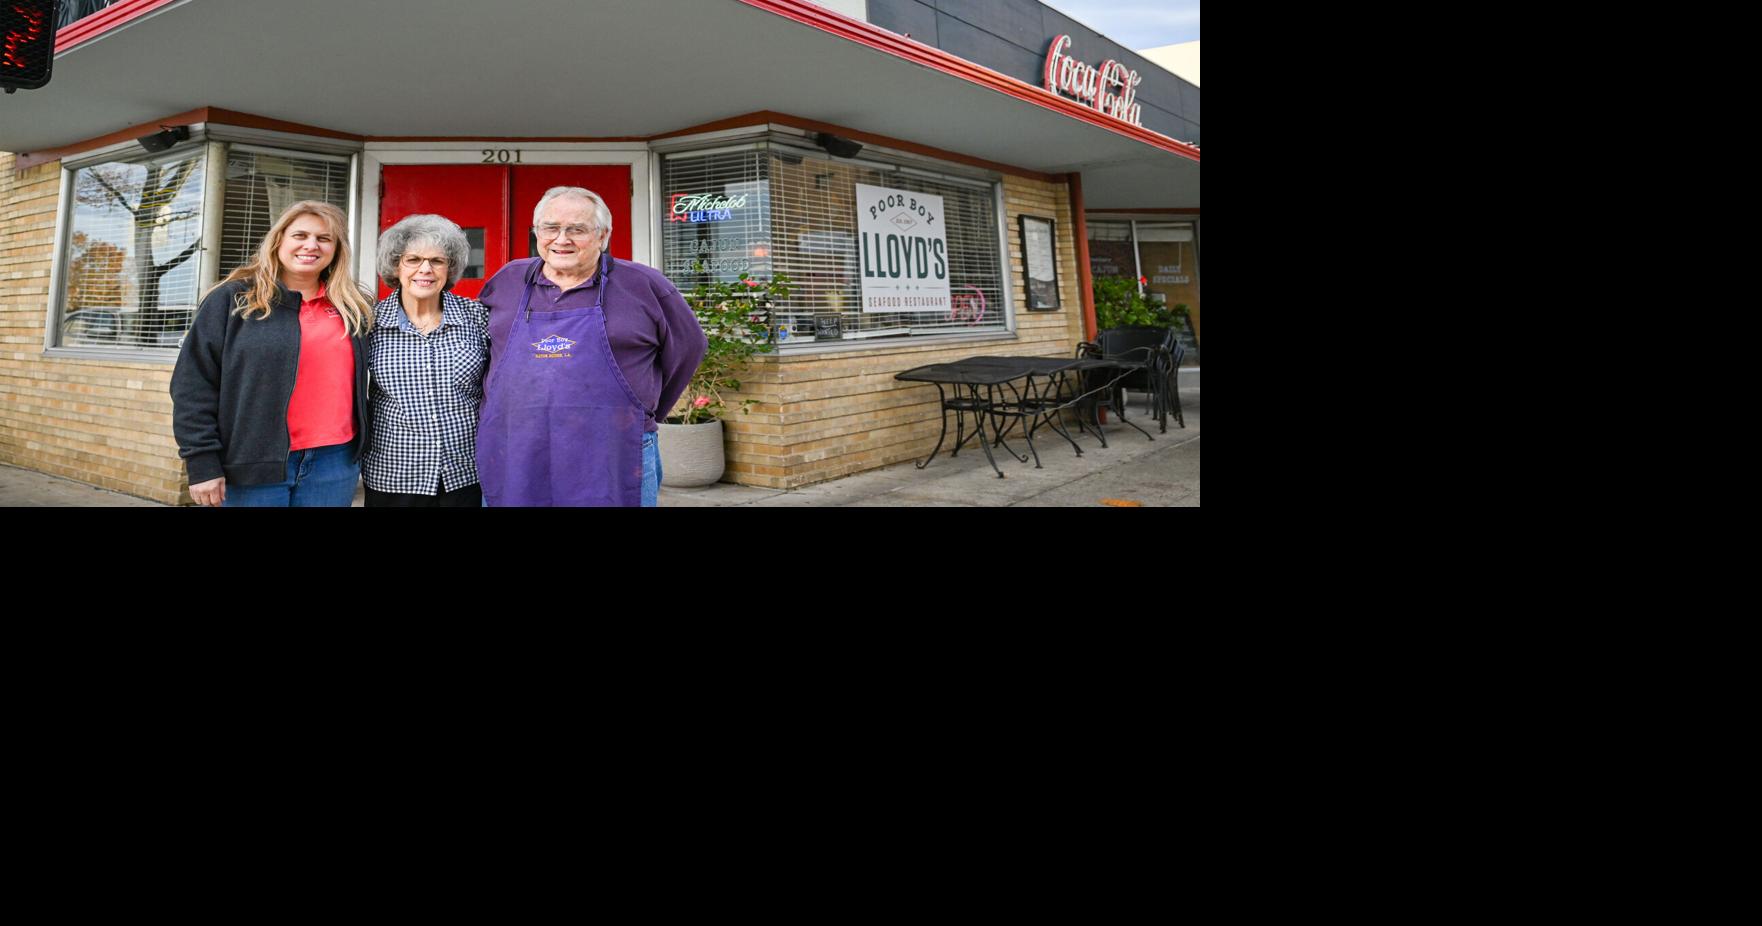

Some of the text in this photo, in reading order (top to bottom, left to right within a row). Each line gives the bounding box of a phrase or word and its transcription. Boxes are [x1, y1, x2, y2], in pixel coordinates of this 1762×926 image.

[482, 149, 522, 163] 201
[673, 193, 749, 214] Michelob
[869, 194, 935, 225] POOR BOY
[689, 208, 732, 222] ULTRA
[862, 231, 946, 280] LLOYD'S
[868, 296, 947, 307] SEAFOOD RESTAURANT
